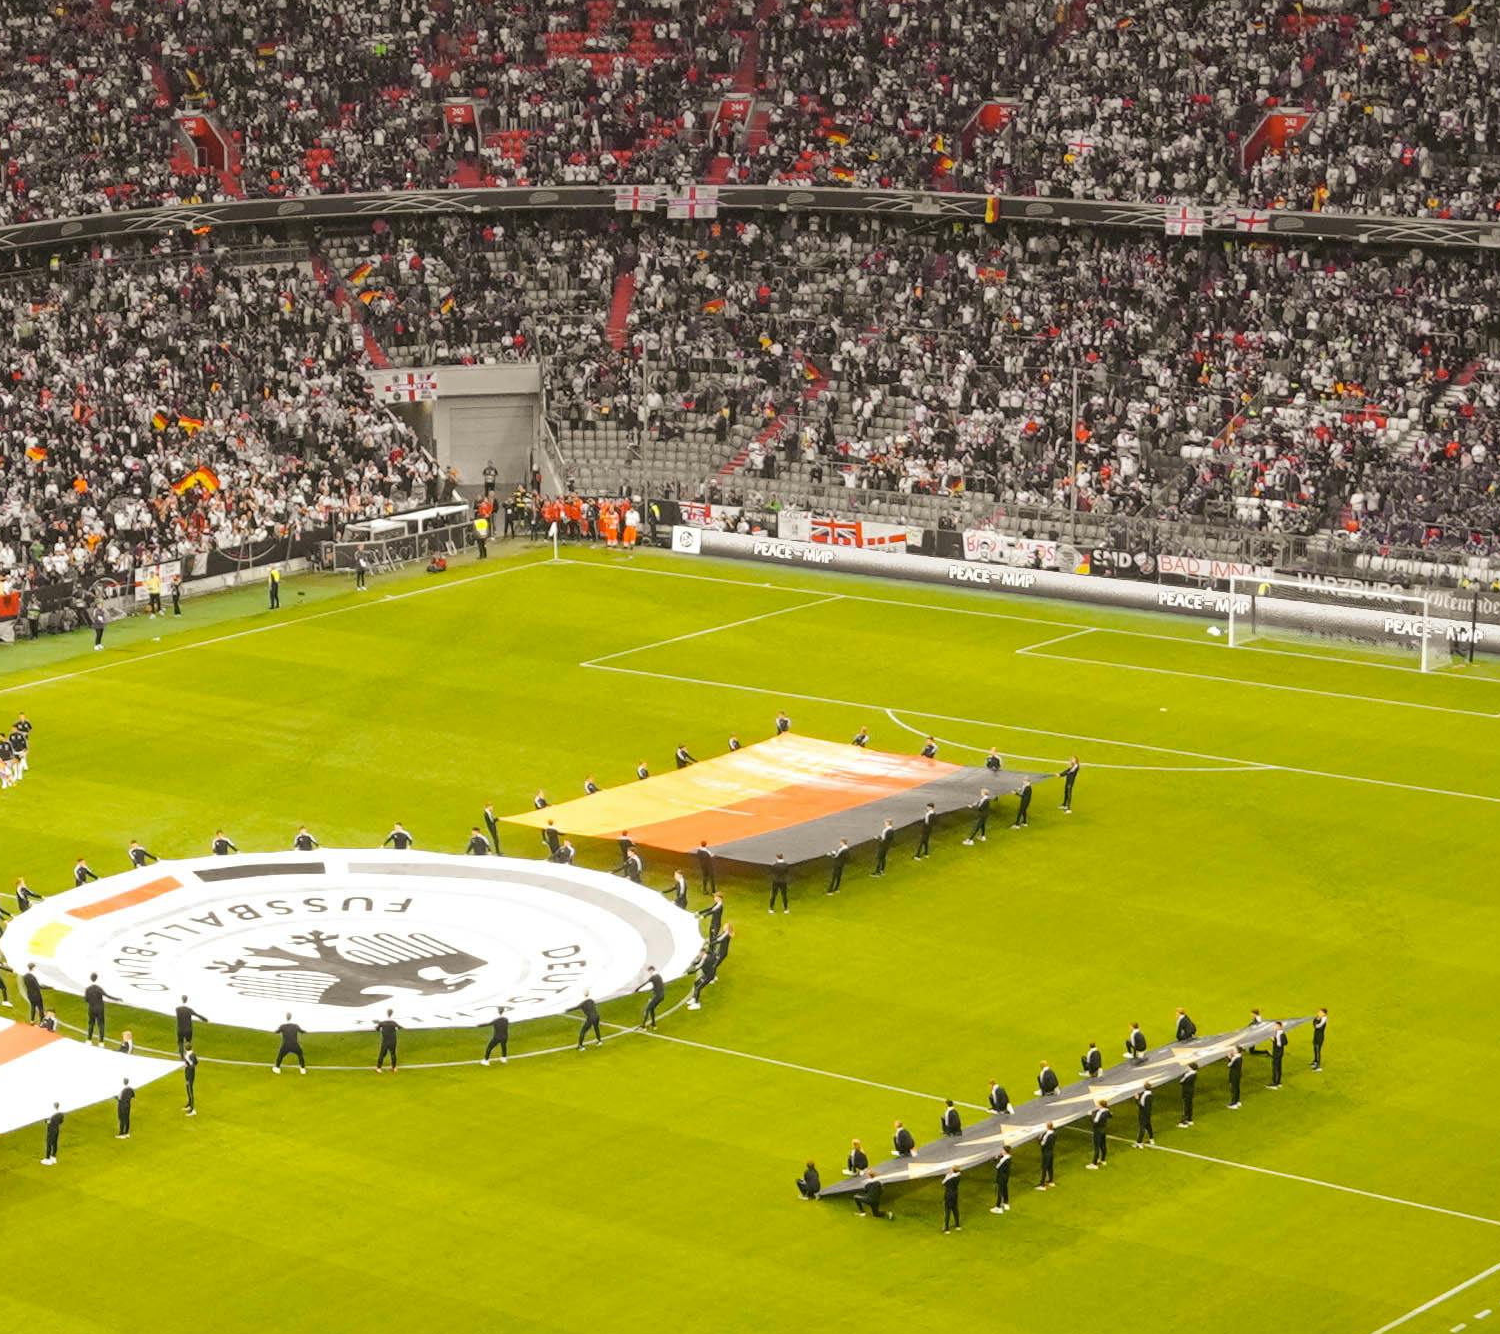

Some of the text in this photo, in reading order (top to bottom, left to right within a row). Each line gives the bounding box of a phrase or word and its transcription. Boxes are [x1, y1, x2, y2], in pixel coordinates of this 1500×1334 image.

[753, 542, 793, 560] PEACE
[948, 564, 991, 585] PEACE
[1157, 590, 1203, 611] PEACE
